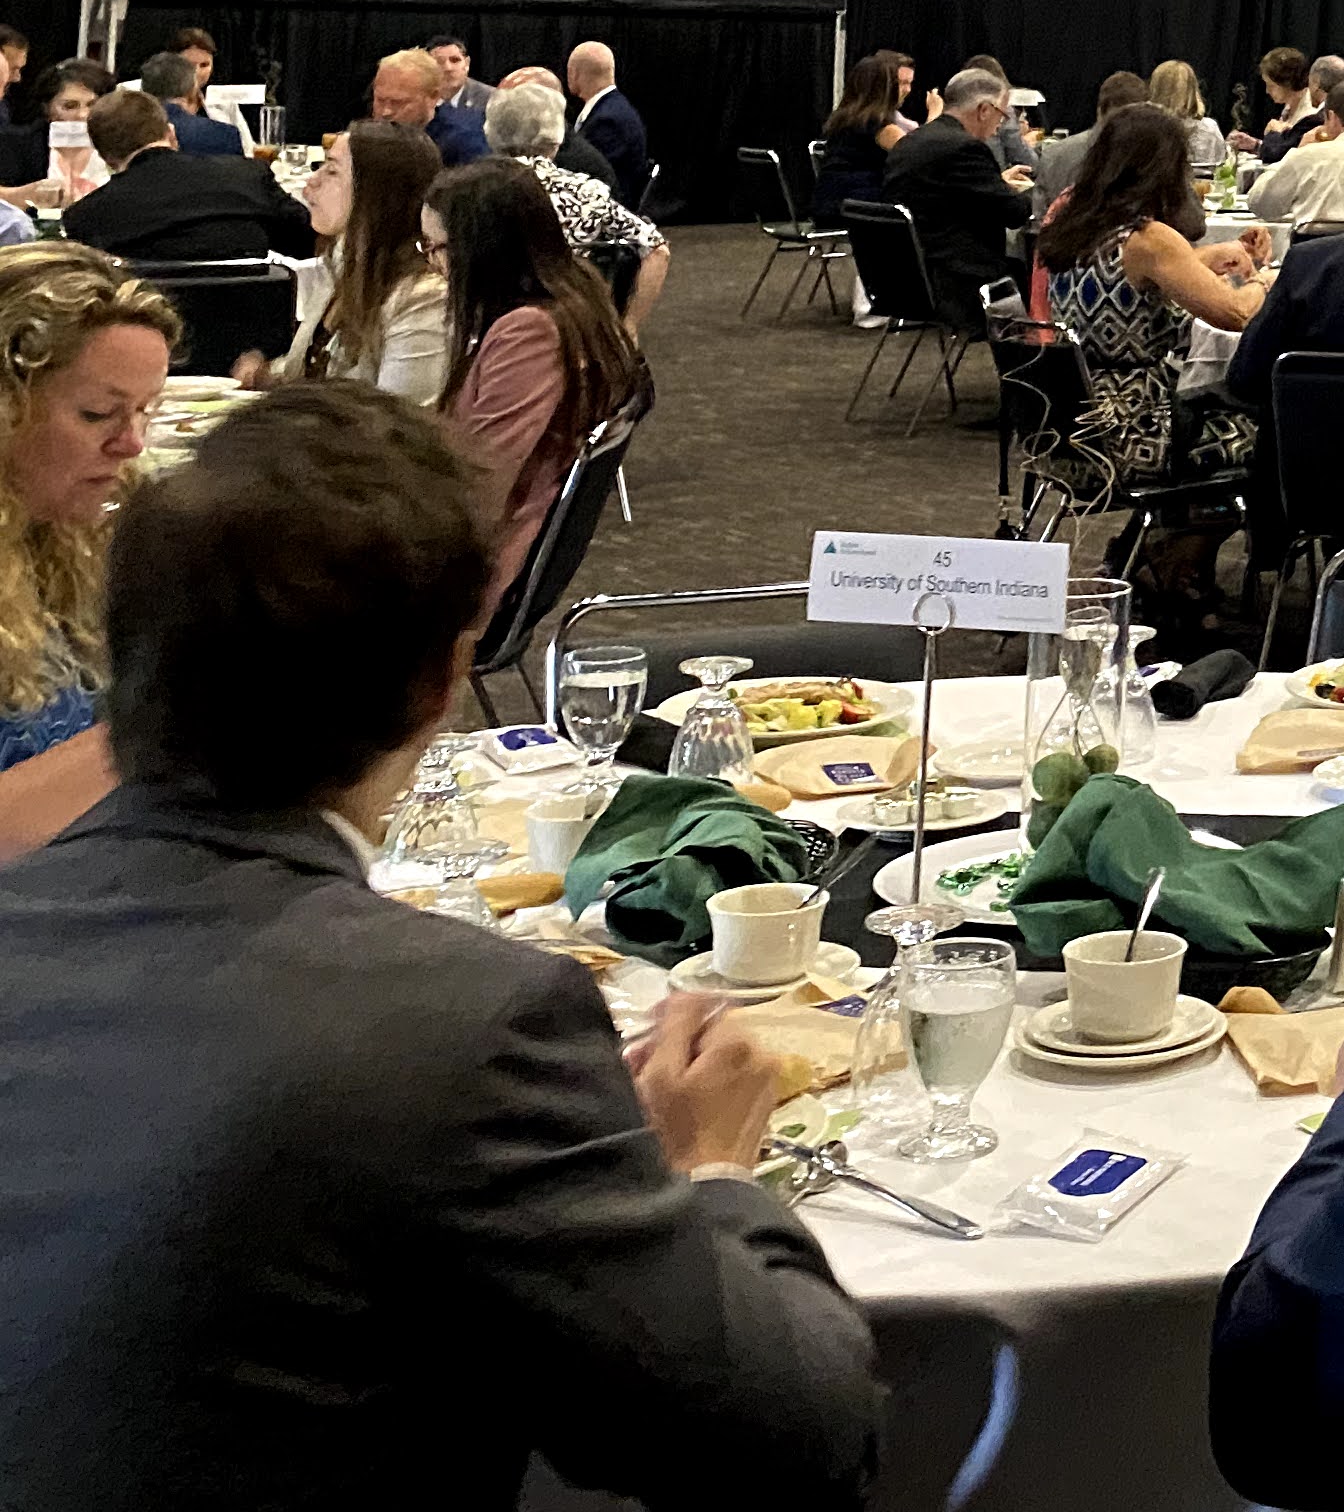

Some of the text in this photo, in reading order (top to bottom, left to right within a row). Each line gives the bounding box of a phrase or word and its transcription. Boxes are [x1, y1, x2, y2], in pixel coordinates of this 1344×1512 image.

[932, 551, 952, 568] 45
[830, 569, 1048, 598] University of Southern Indiana
